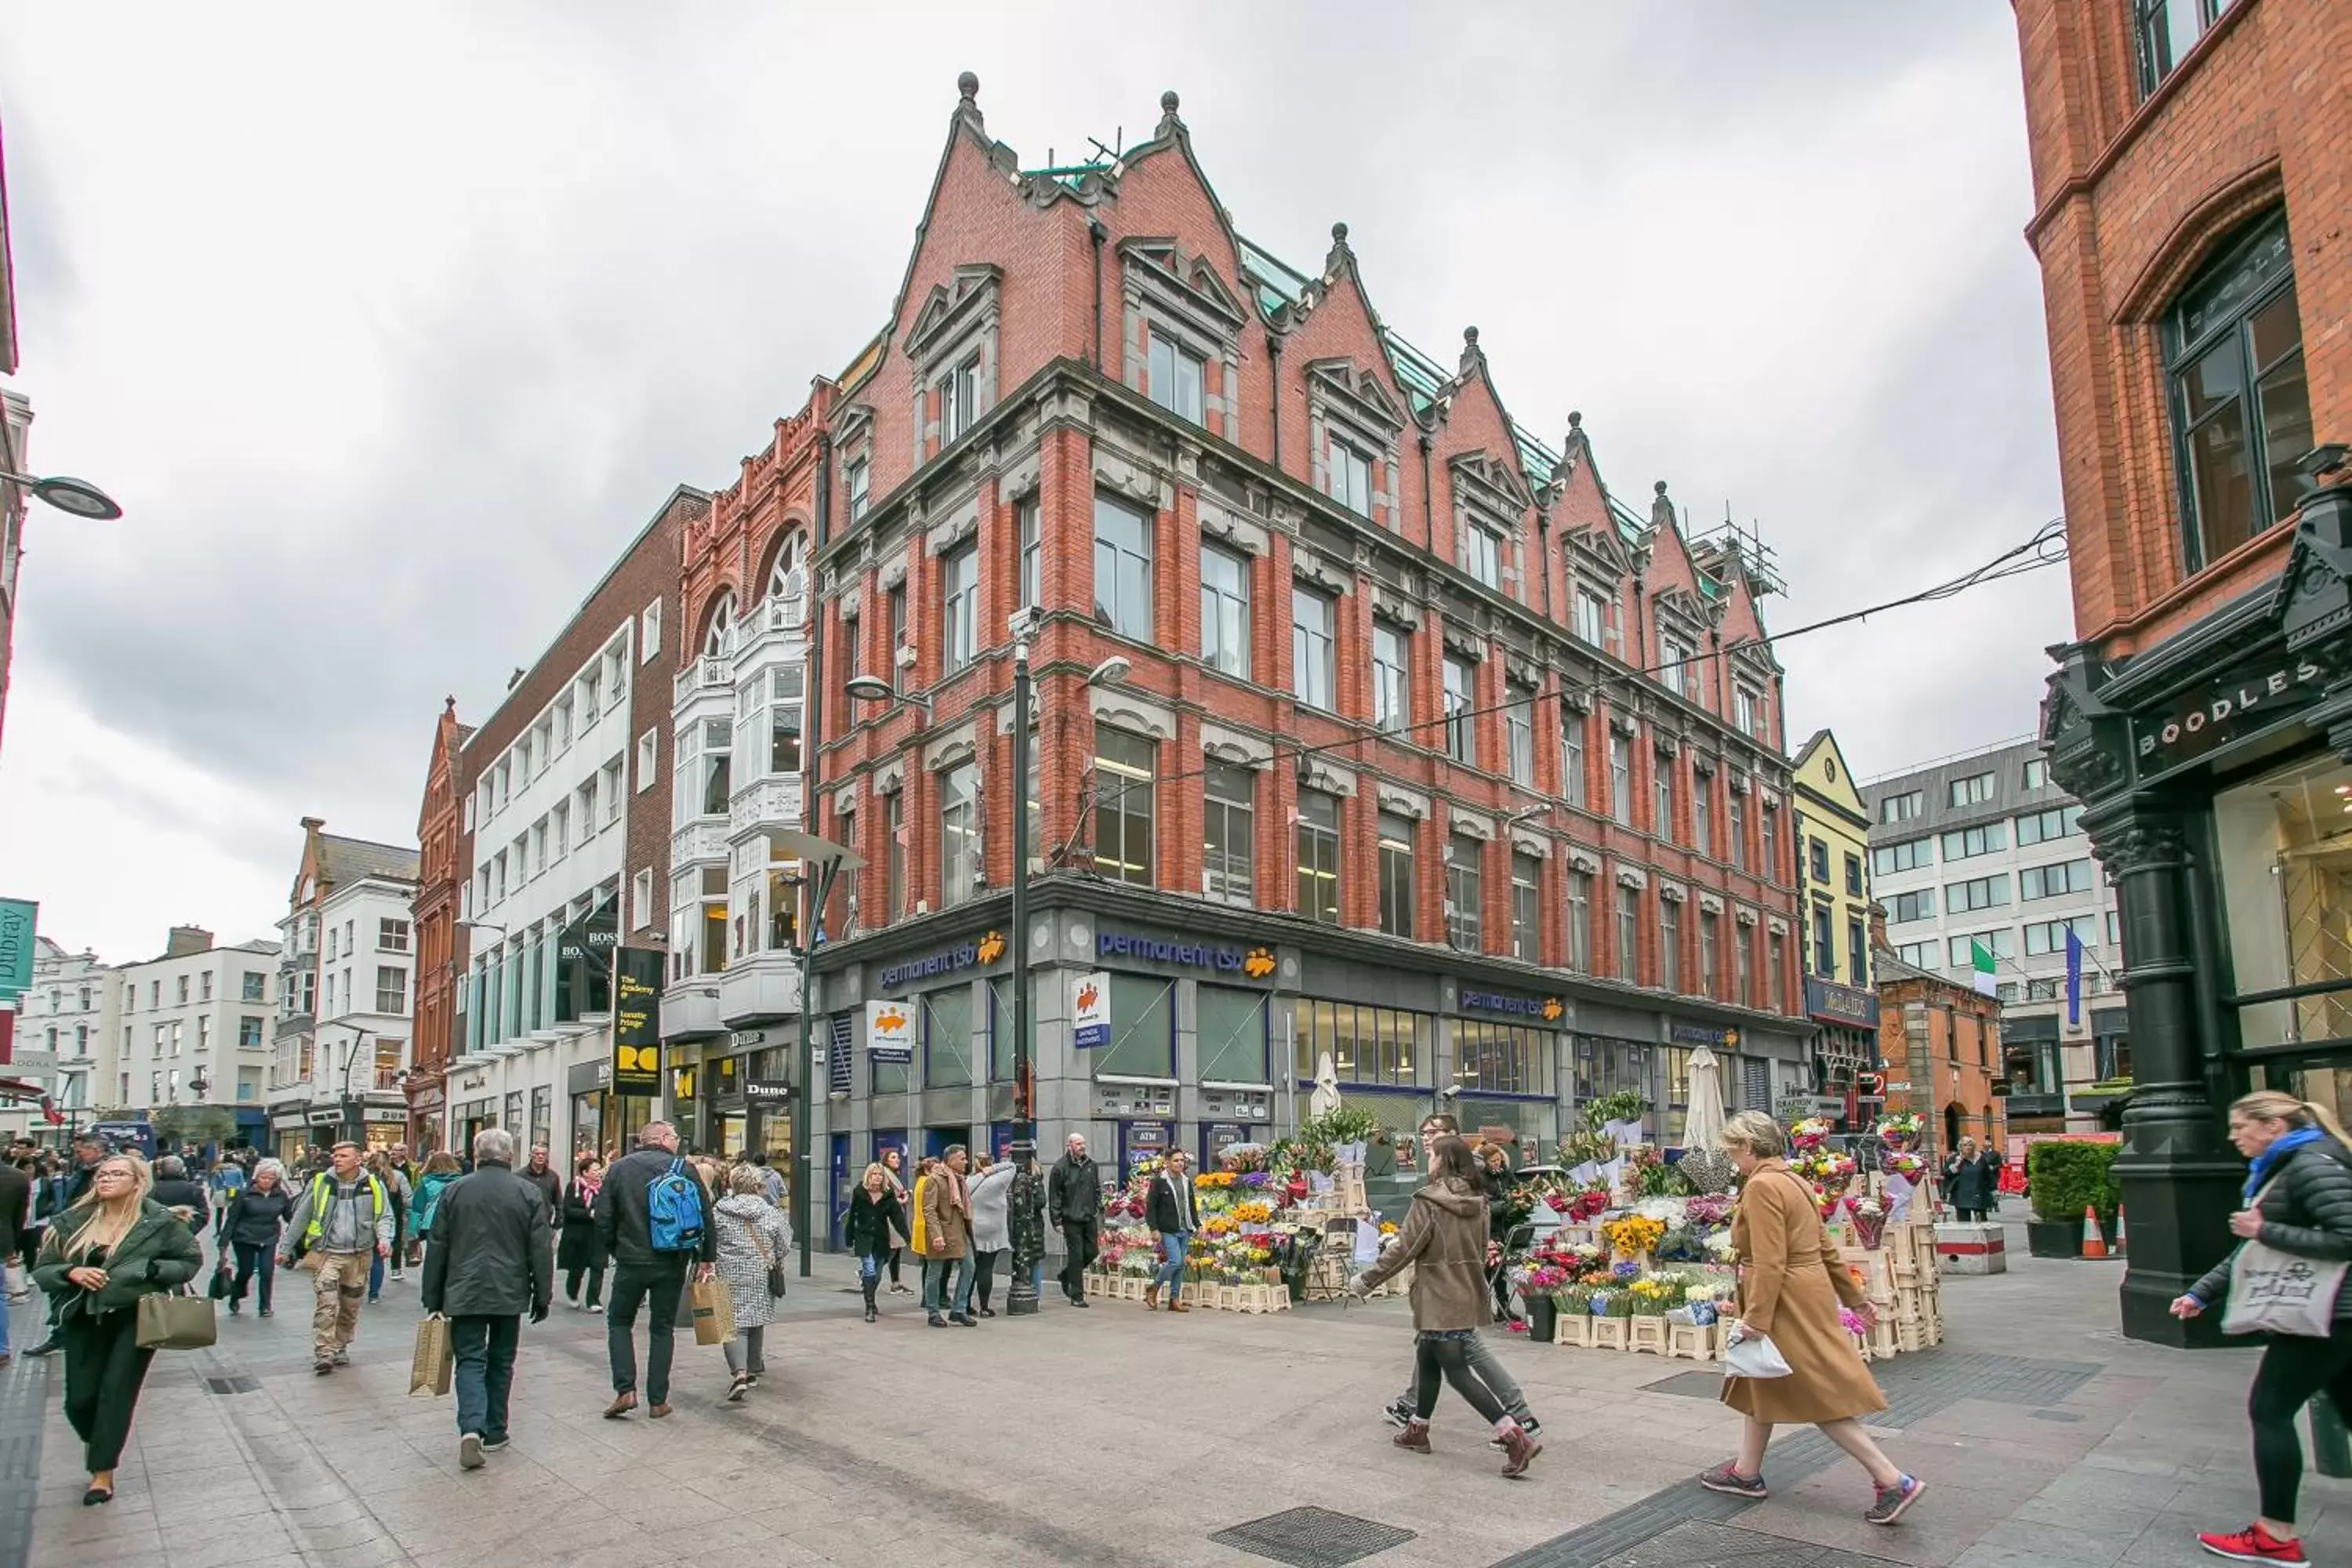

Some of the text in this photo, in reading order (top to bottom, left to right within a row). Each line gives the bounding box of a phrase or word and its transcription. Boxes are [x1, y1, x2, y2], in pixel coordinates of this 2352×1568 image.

[2138, 660, 2319, 757] BOODLES
[0, 907, 28, 979] Dubray
[562, 946, 583, 956] BO
[1097, 932, 1241, 970] permanent tsb
[879, 942, 975, 989] permanent tsb
[620, 984, 655, 996] Academy
[1463, 990, 1526, 1014] permanent
[746, 1084, 788, 1095] Dune
[1139, 1132, 1156, 1141] ATM
